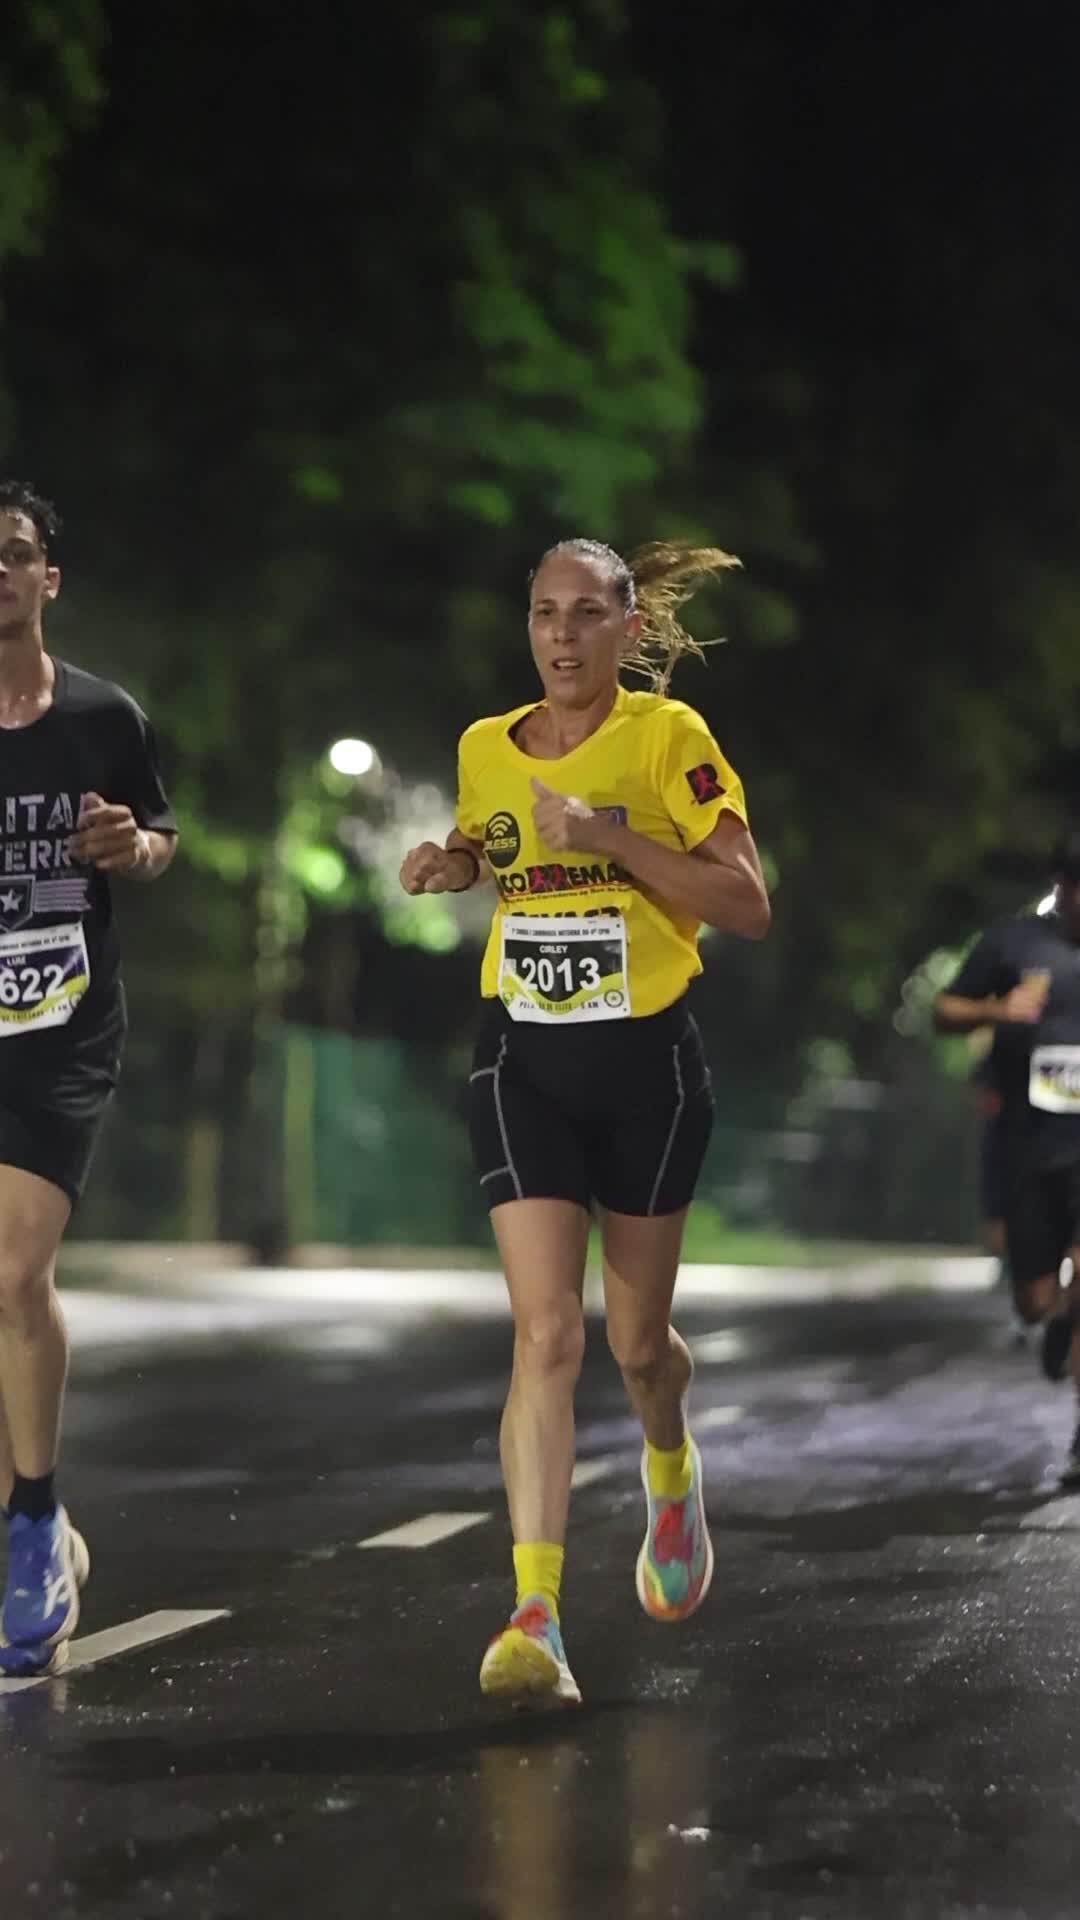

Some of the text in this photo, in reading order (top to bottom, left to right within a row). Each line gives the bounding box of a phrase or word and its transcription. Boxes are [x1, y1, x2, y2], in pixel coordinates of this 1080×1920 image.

[0, 792, 86, 834] ITA
[0, 964, 65, 1005] 622
[521, 957, 601, 992] 2013
